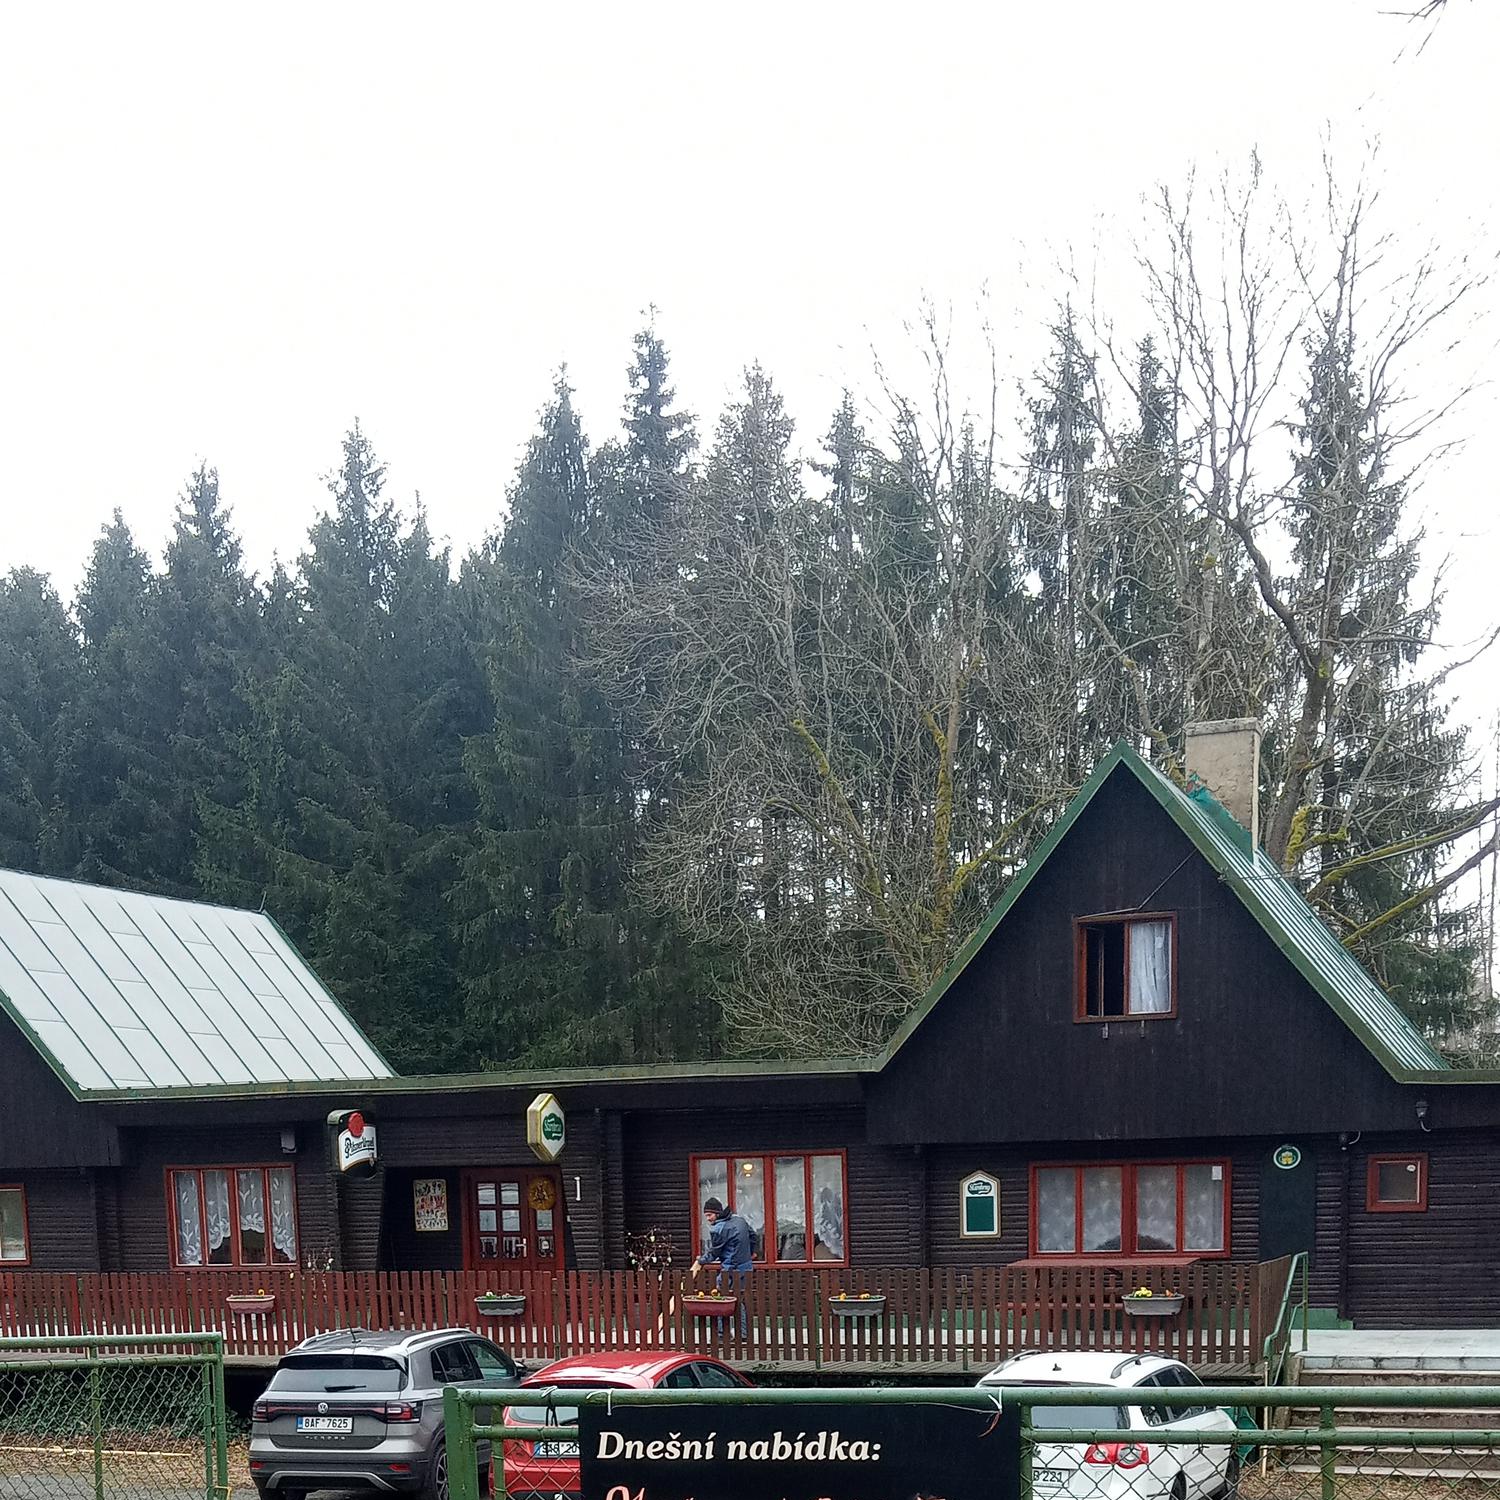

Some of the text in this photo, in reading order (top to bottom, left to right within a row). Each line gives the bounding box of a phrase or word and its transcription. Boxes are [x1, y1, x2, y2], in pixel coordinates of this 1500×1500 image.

[304, 1418, 349, 1429] 8AF 7625
[597, 1431, 882, 1461] Dnešní nabídka:
